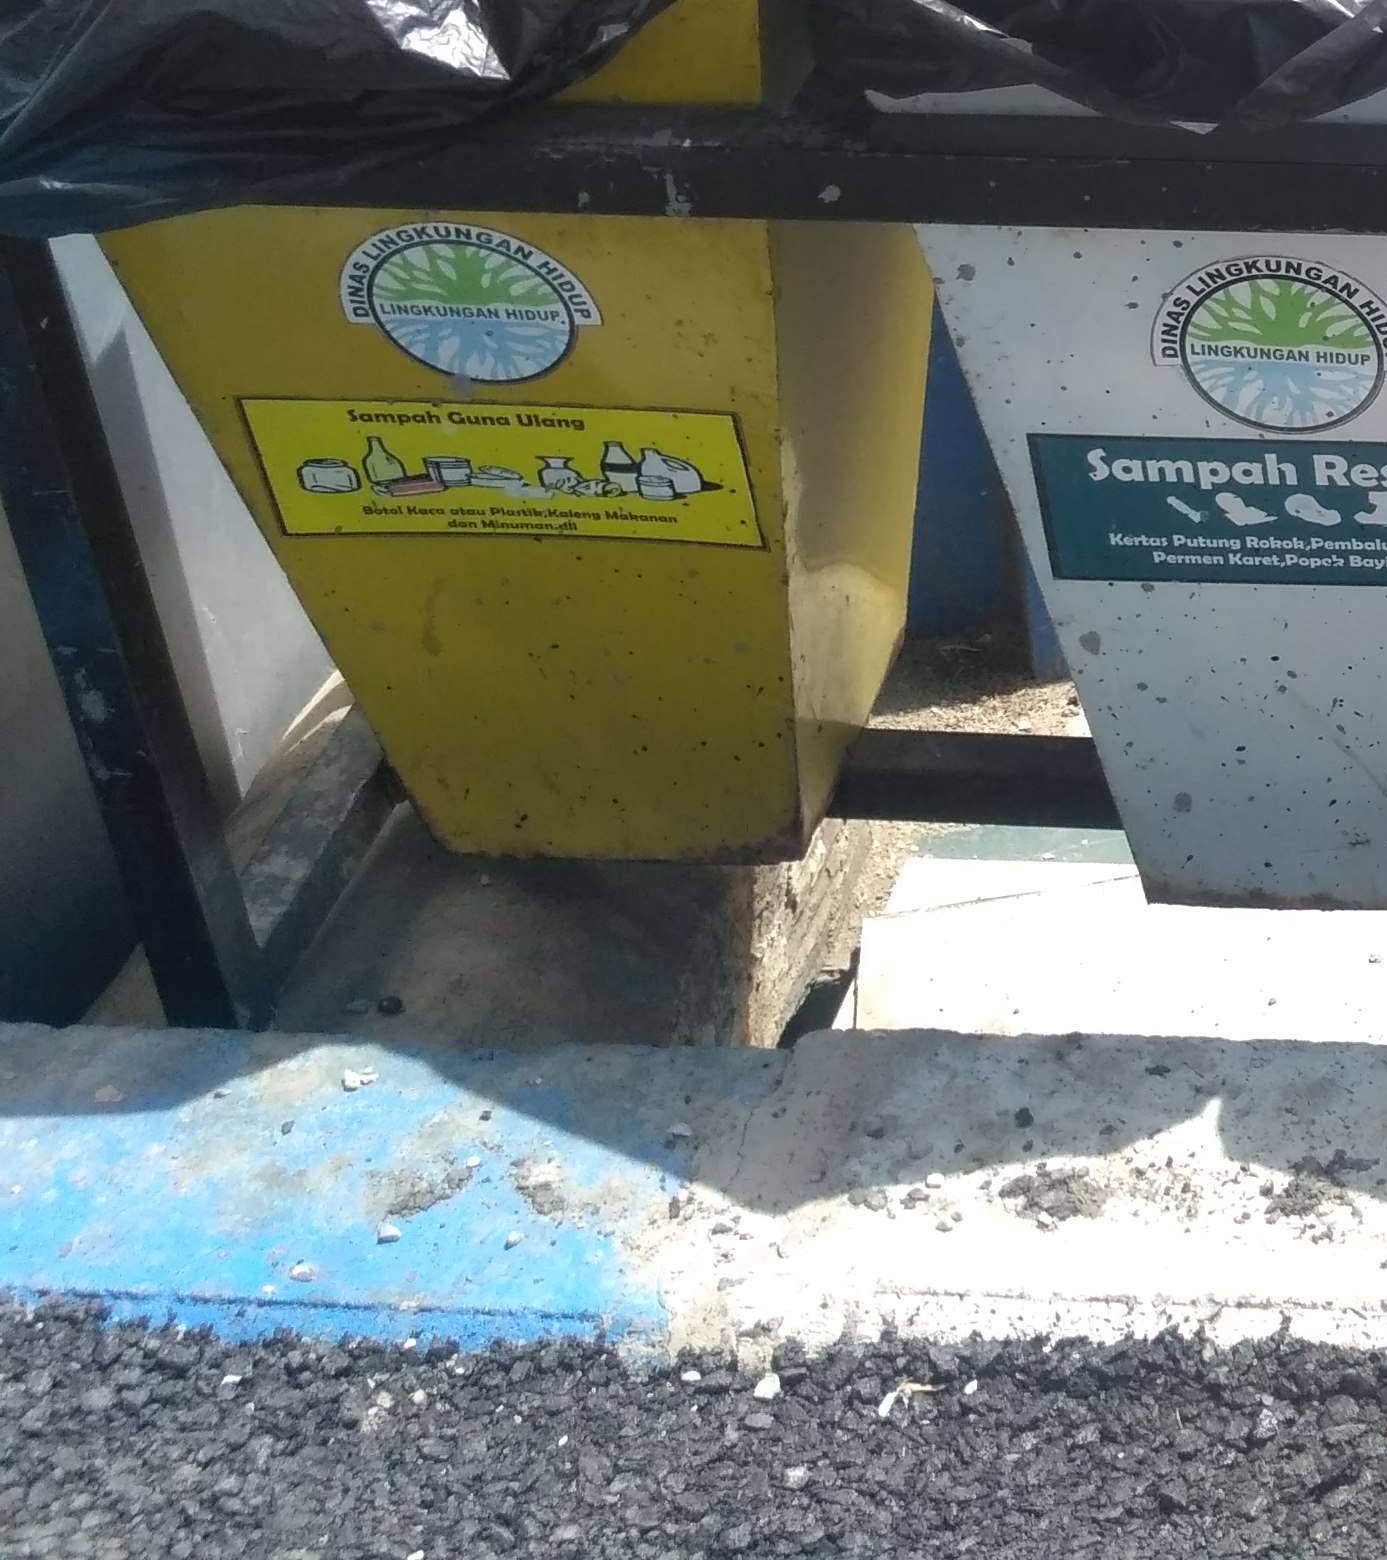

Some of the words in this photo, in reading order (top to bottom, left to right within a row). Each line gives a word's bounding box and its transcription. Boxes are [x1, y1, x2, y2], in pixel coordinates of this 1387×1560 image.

[348, 261, 370, 318] DINAS
[368, 225, 533, 262] LINGKUNGAN
[536, 260, 592, 320] HIDUP
[380, 302, 500, 320] LINGKUNGAN
[505, 308, 560, 322] HIDUP
[1161, 296, 1190, 359] DINAS
[1190, 258, 1359, 299] LINGKUNGAN
[1190, 343, 1310, 363] LINGKUNGAN
[1315, 349, 1371, 367] HIDUP
[347, 408, 441, 426] Sampah
[447, 411, 510, 427] Guna
[516, 413, 585, 430] Ulang
[1087, 447, 1298, 491] Sampah
[362, 505, 403, 516] Botol
[407, 505, 446, 516] Kaca
[450, 507, 486, 517] atau
[605, 511, 678, 524] Makanan
[448, 519, 477, 529] dan
[1109, 532, 1168, 548] Kertas
[1172, 534, 1241, 552] Putung
[1152, 552, 1224, 566] Permen
